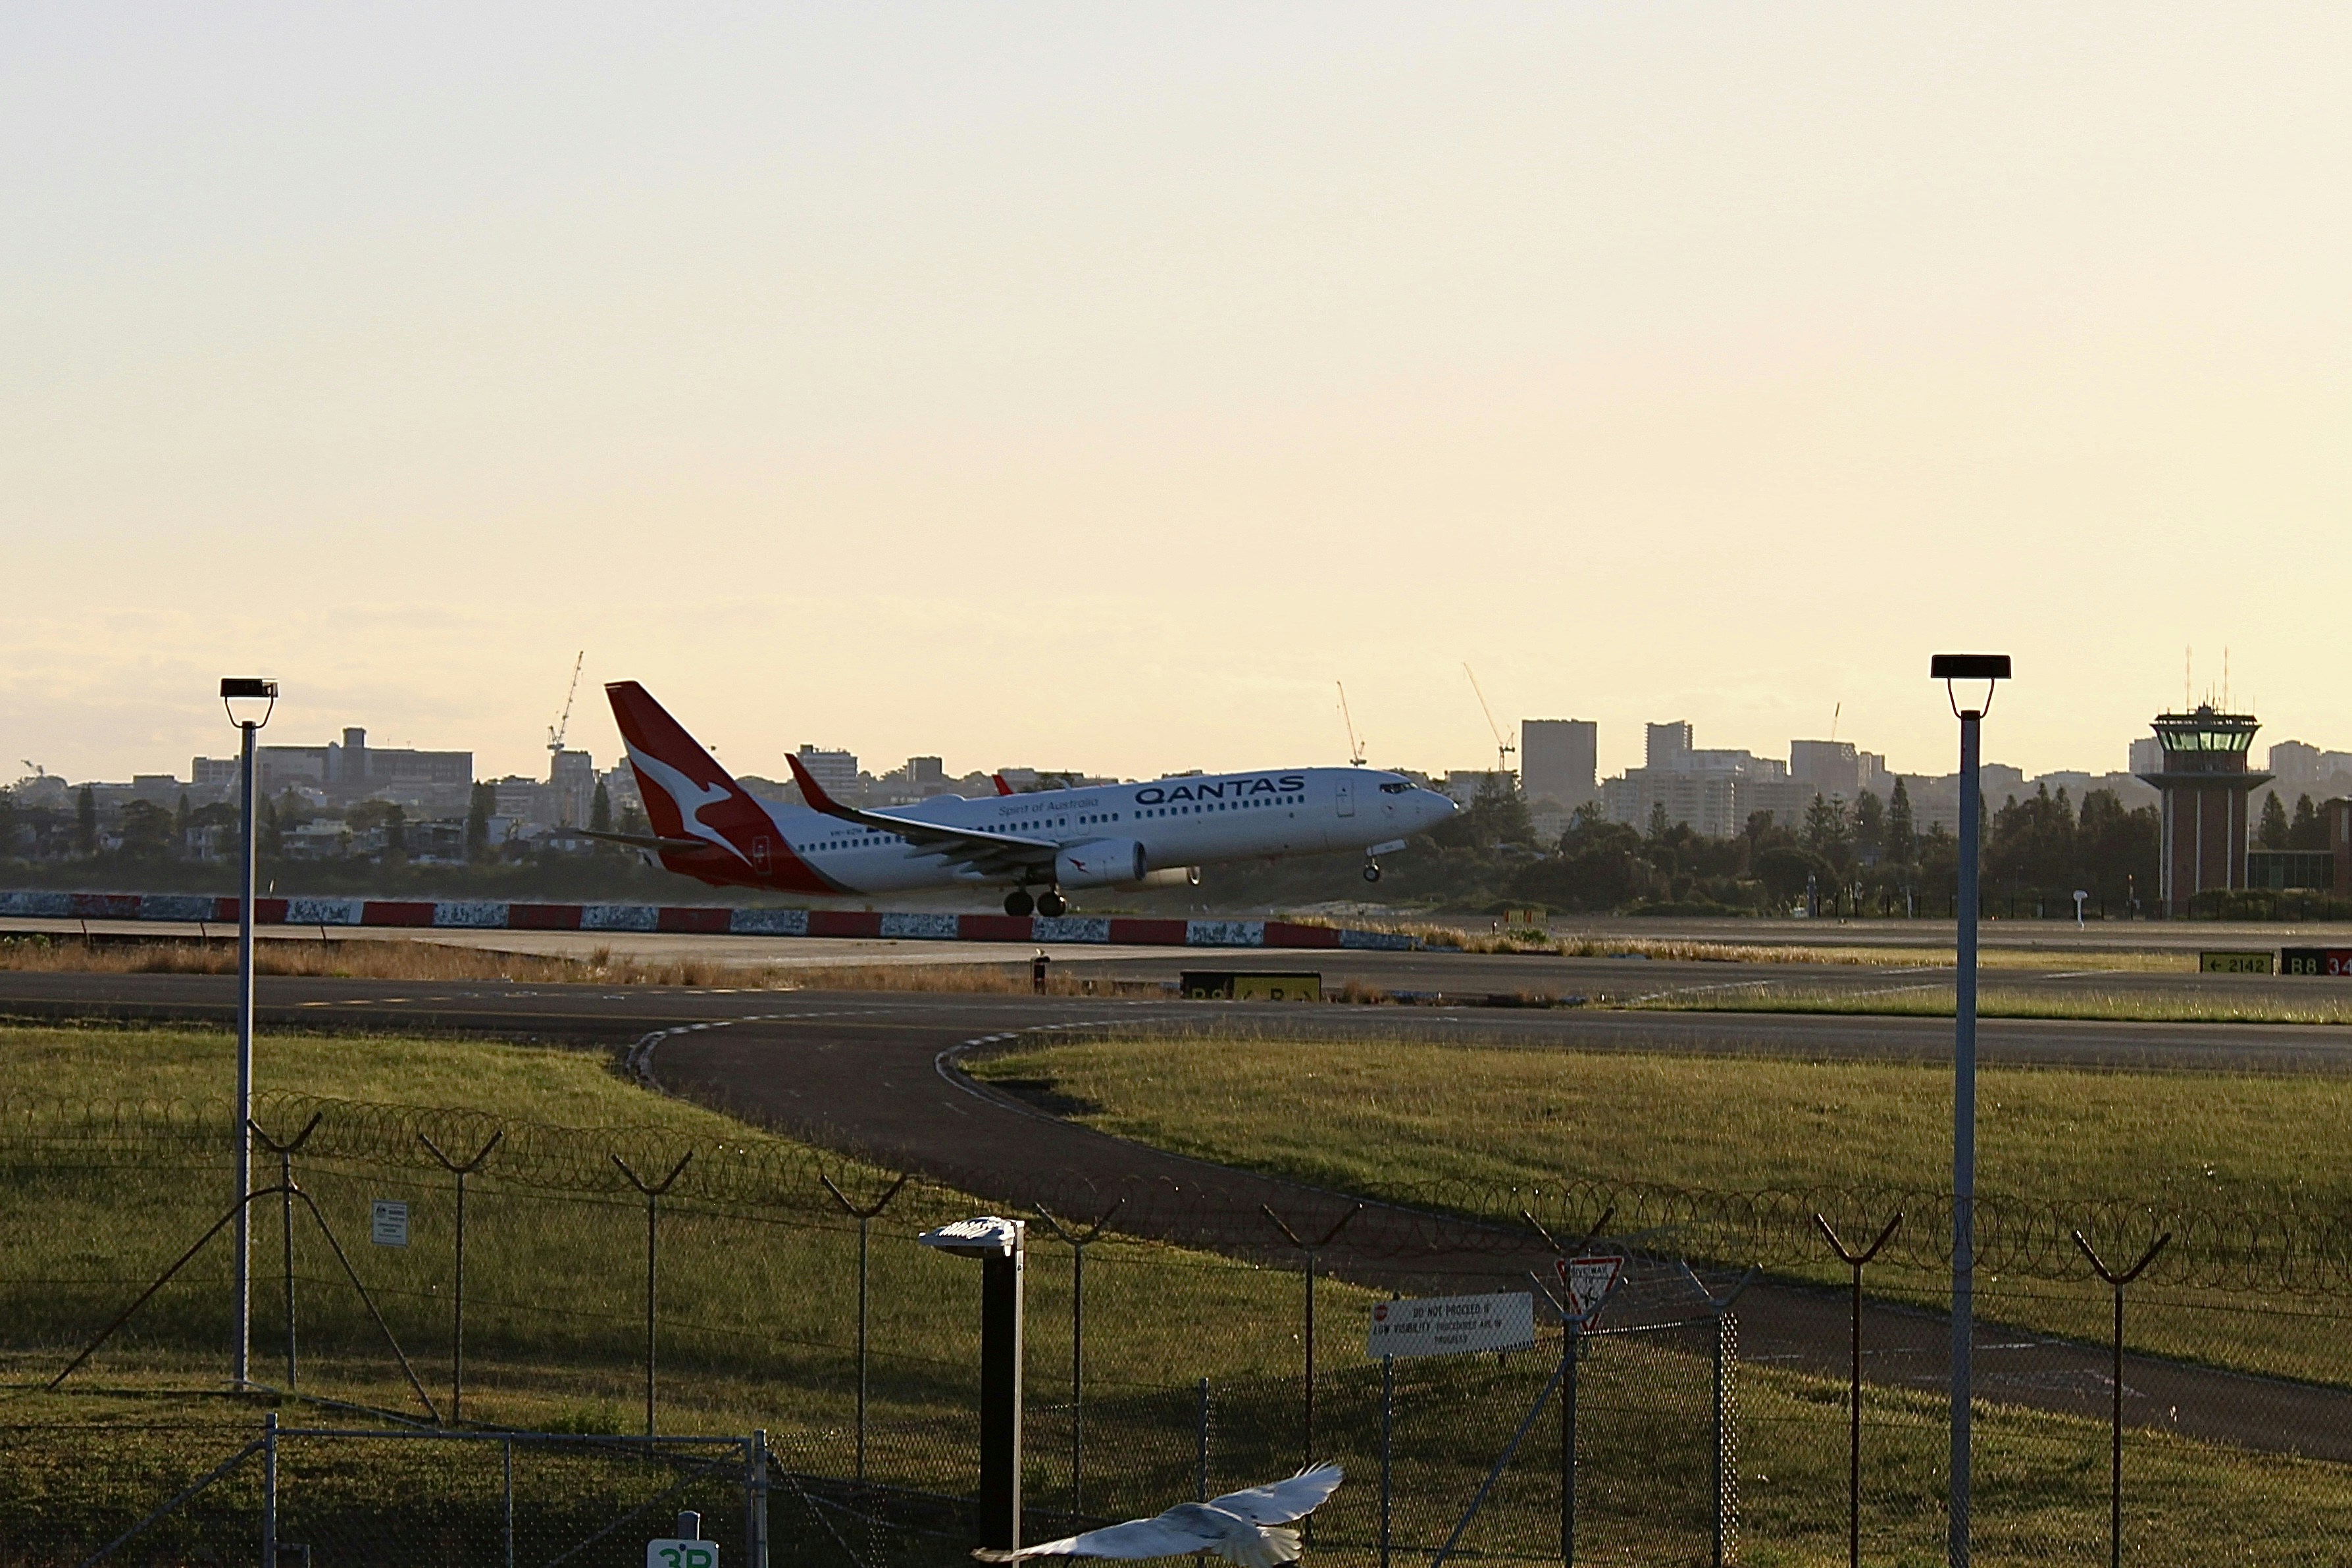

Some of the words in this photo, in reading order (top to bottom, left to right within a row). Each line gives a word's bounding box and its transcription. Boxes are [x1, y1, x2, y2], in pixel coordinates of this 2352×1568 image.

[1135, 776, 1304, 805] QANTAS
[998, 805, 1029, 817] Spirit
[1032, 802, 1044, 813] of
[1046, 798, 1098, 811] Australia
[2228, 958, 2264, 973] 2142
[1413, 1307, 1424, 1318] DO
[1427, 1305, 1443, 1317] NOT
[1446, 1303, 1480, 1316] PROCEED
[1483, 1303, 1491, 1314] IF
[1373, 1324, 1390, 1335] LOW
[1394, 1321, 1430, 1333] VISIBILITY
